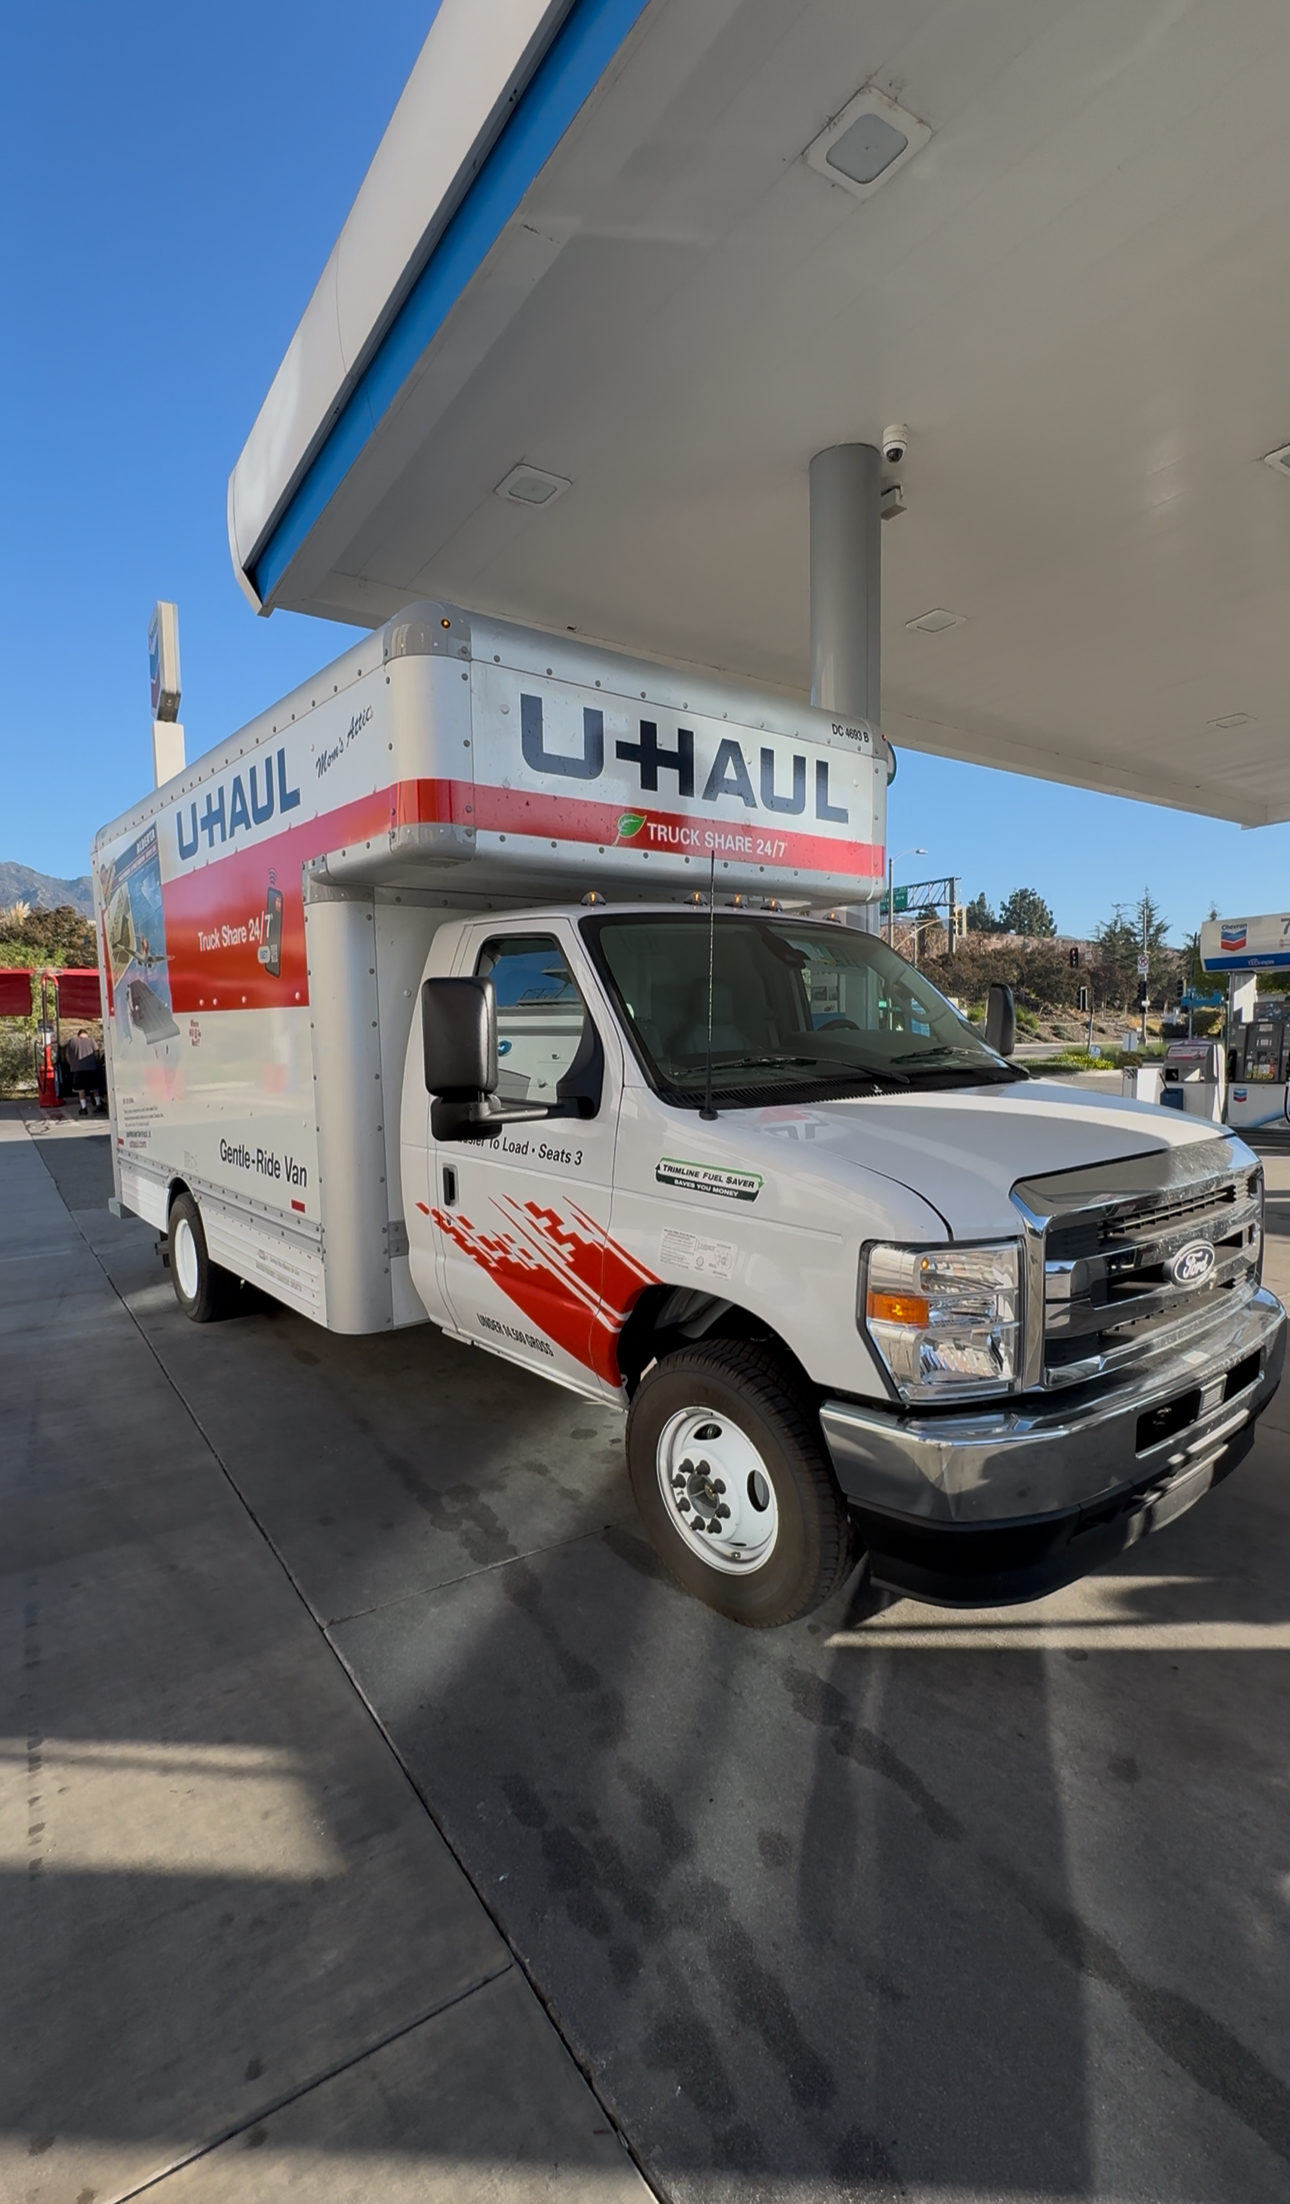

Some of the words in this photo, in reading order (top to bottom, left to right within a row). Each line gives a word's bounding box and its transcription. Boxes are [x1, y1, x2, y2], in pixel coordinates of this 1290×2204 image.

[315, 736, 345, 779] Mom's
[346, 705, 373, 748] Attic
[832, 723, 844, 737] DC
[863, 731, 870, 743] B
[646, 822, 701, 846] TRUCK
[704, 831, 753, 853] SHARE
[756, 839, 787, 858] 24/7
[198, 931, 221, 952] Truck
[221, 925, 247, 948] Share
[248, 911, 272, 945] 24/7
[1221, 923, 1248, 931] Chevron
[219, 1138, 281, 1180] Gentle-Ride
[284, 1155, 308, 1188] Van
[502, 1136, 530, 1156] Load
[538, 1143, 572, 1164] Seats
[574, 1150, 584, 1166] 3
[663, 1163, 700, 1179] TRIMLINE
[702, 1172, 723, 1183] FUEL
[725, 1176, 755, 1189] SAVER
[674, 1178, 696, 1189] SAVES
[696, 1183, 711, 1192] YOU
[712, 1185, 739, 1198] MONEY
[1183, 1250, 1209, 1279] Ford
[476, 1312, 504, 1336] UNDER
[525, 1333, 555, 1357] GROSS
